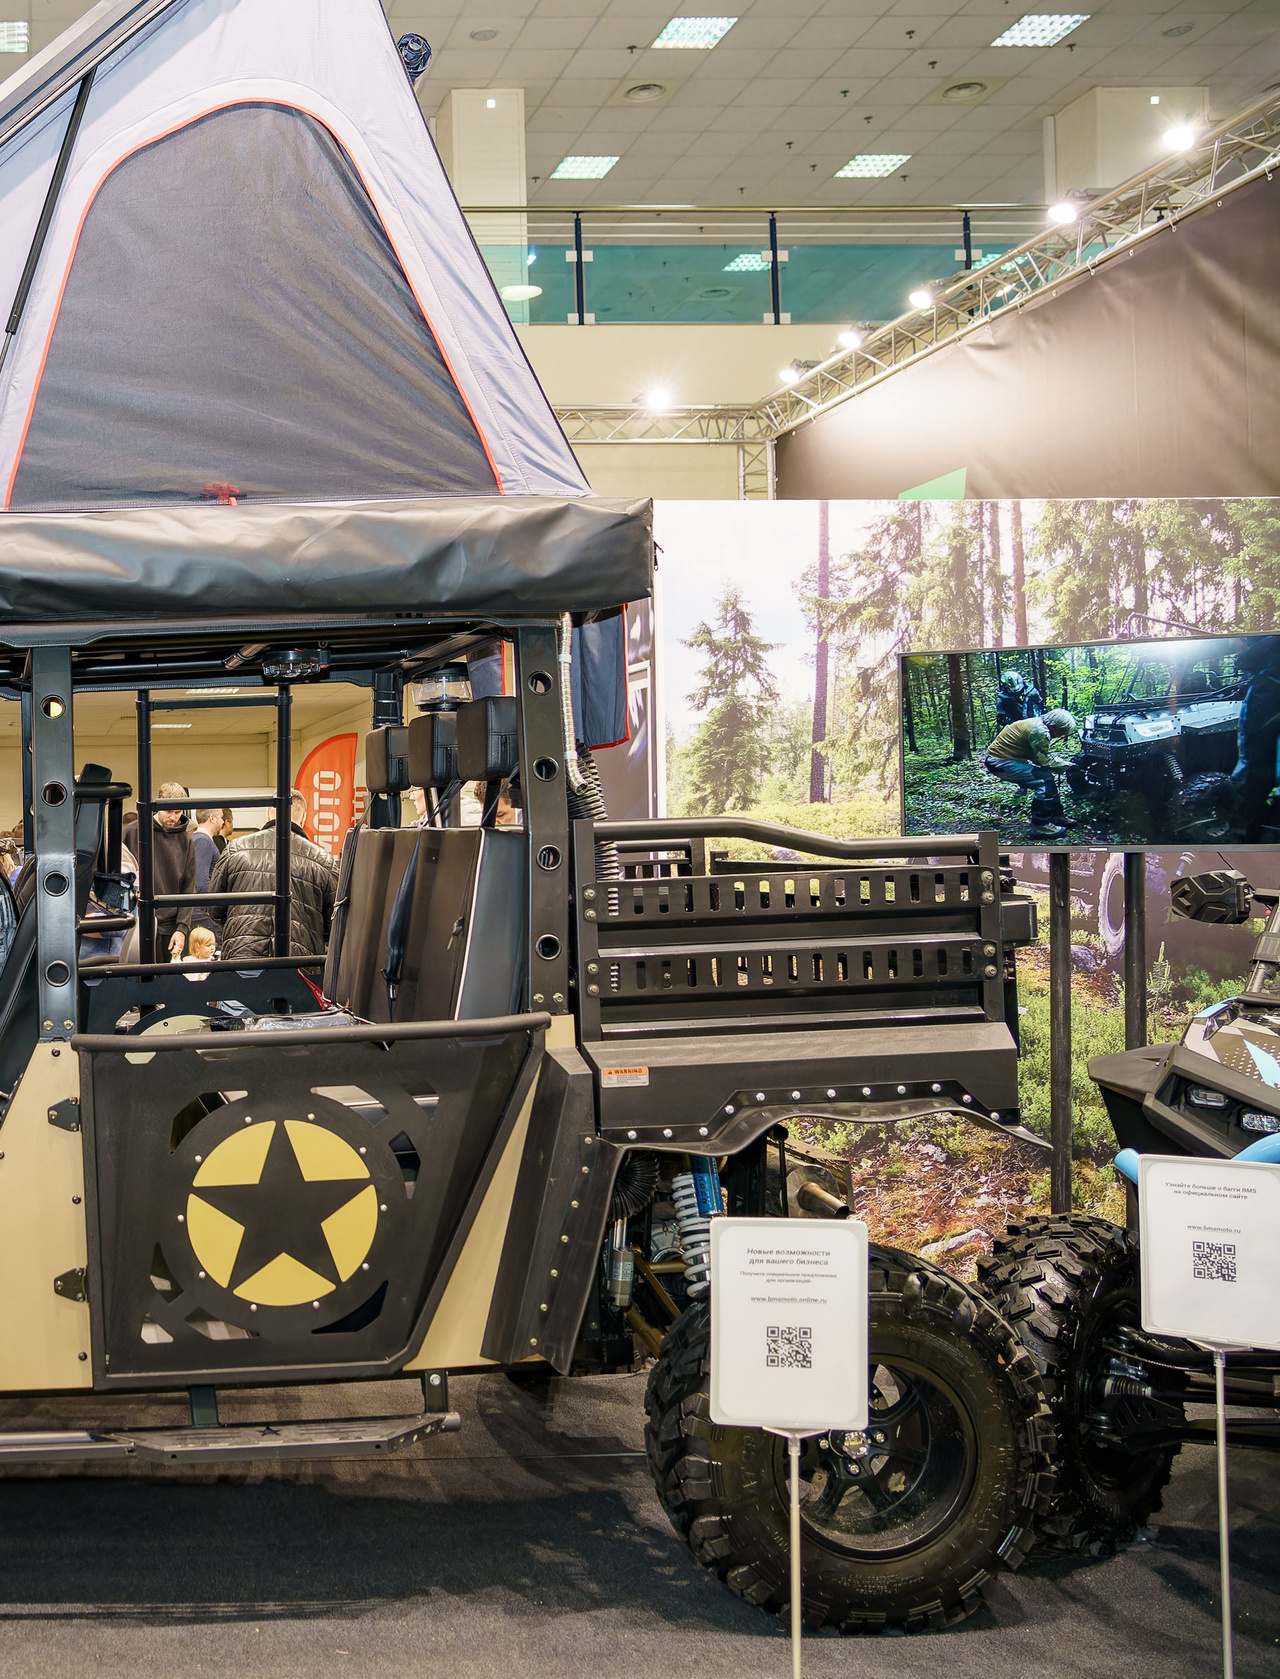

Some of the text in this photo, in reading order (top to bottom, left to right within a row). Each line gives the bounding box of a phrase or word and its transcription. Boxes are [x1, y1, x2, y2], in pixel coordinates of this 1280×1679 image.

[1165, 1181, 1191, 1189] Узнайте
[1192, 1183, 1217, 1191] больше
[1182, 1190, 1228, 1198] официальном
[1187, 1224, 1241, 1234] www.bmsmoto.ru
[775, 1249, 831, 1257] возможности
[796, 1258, 829, 1266] бизнеса
